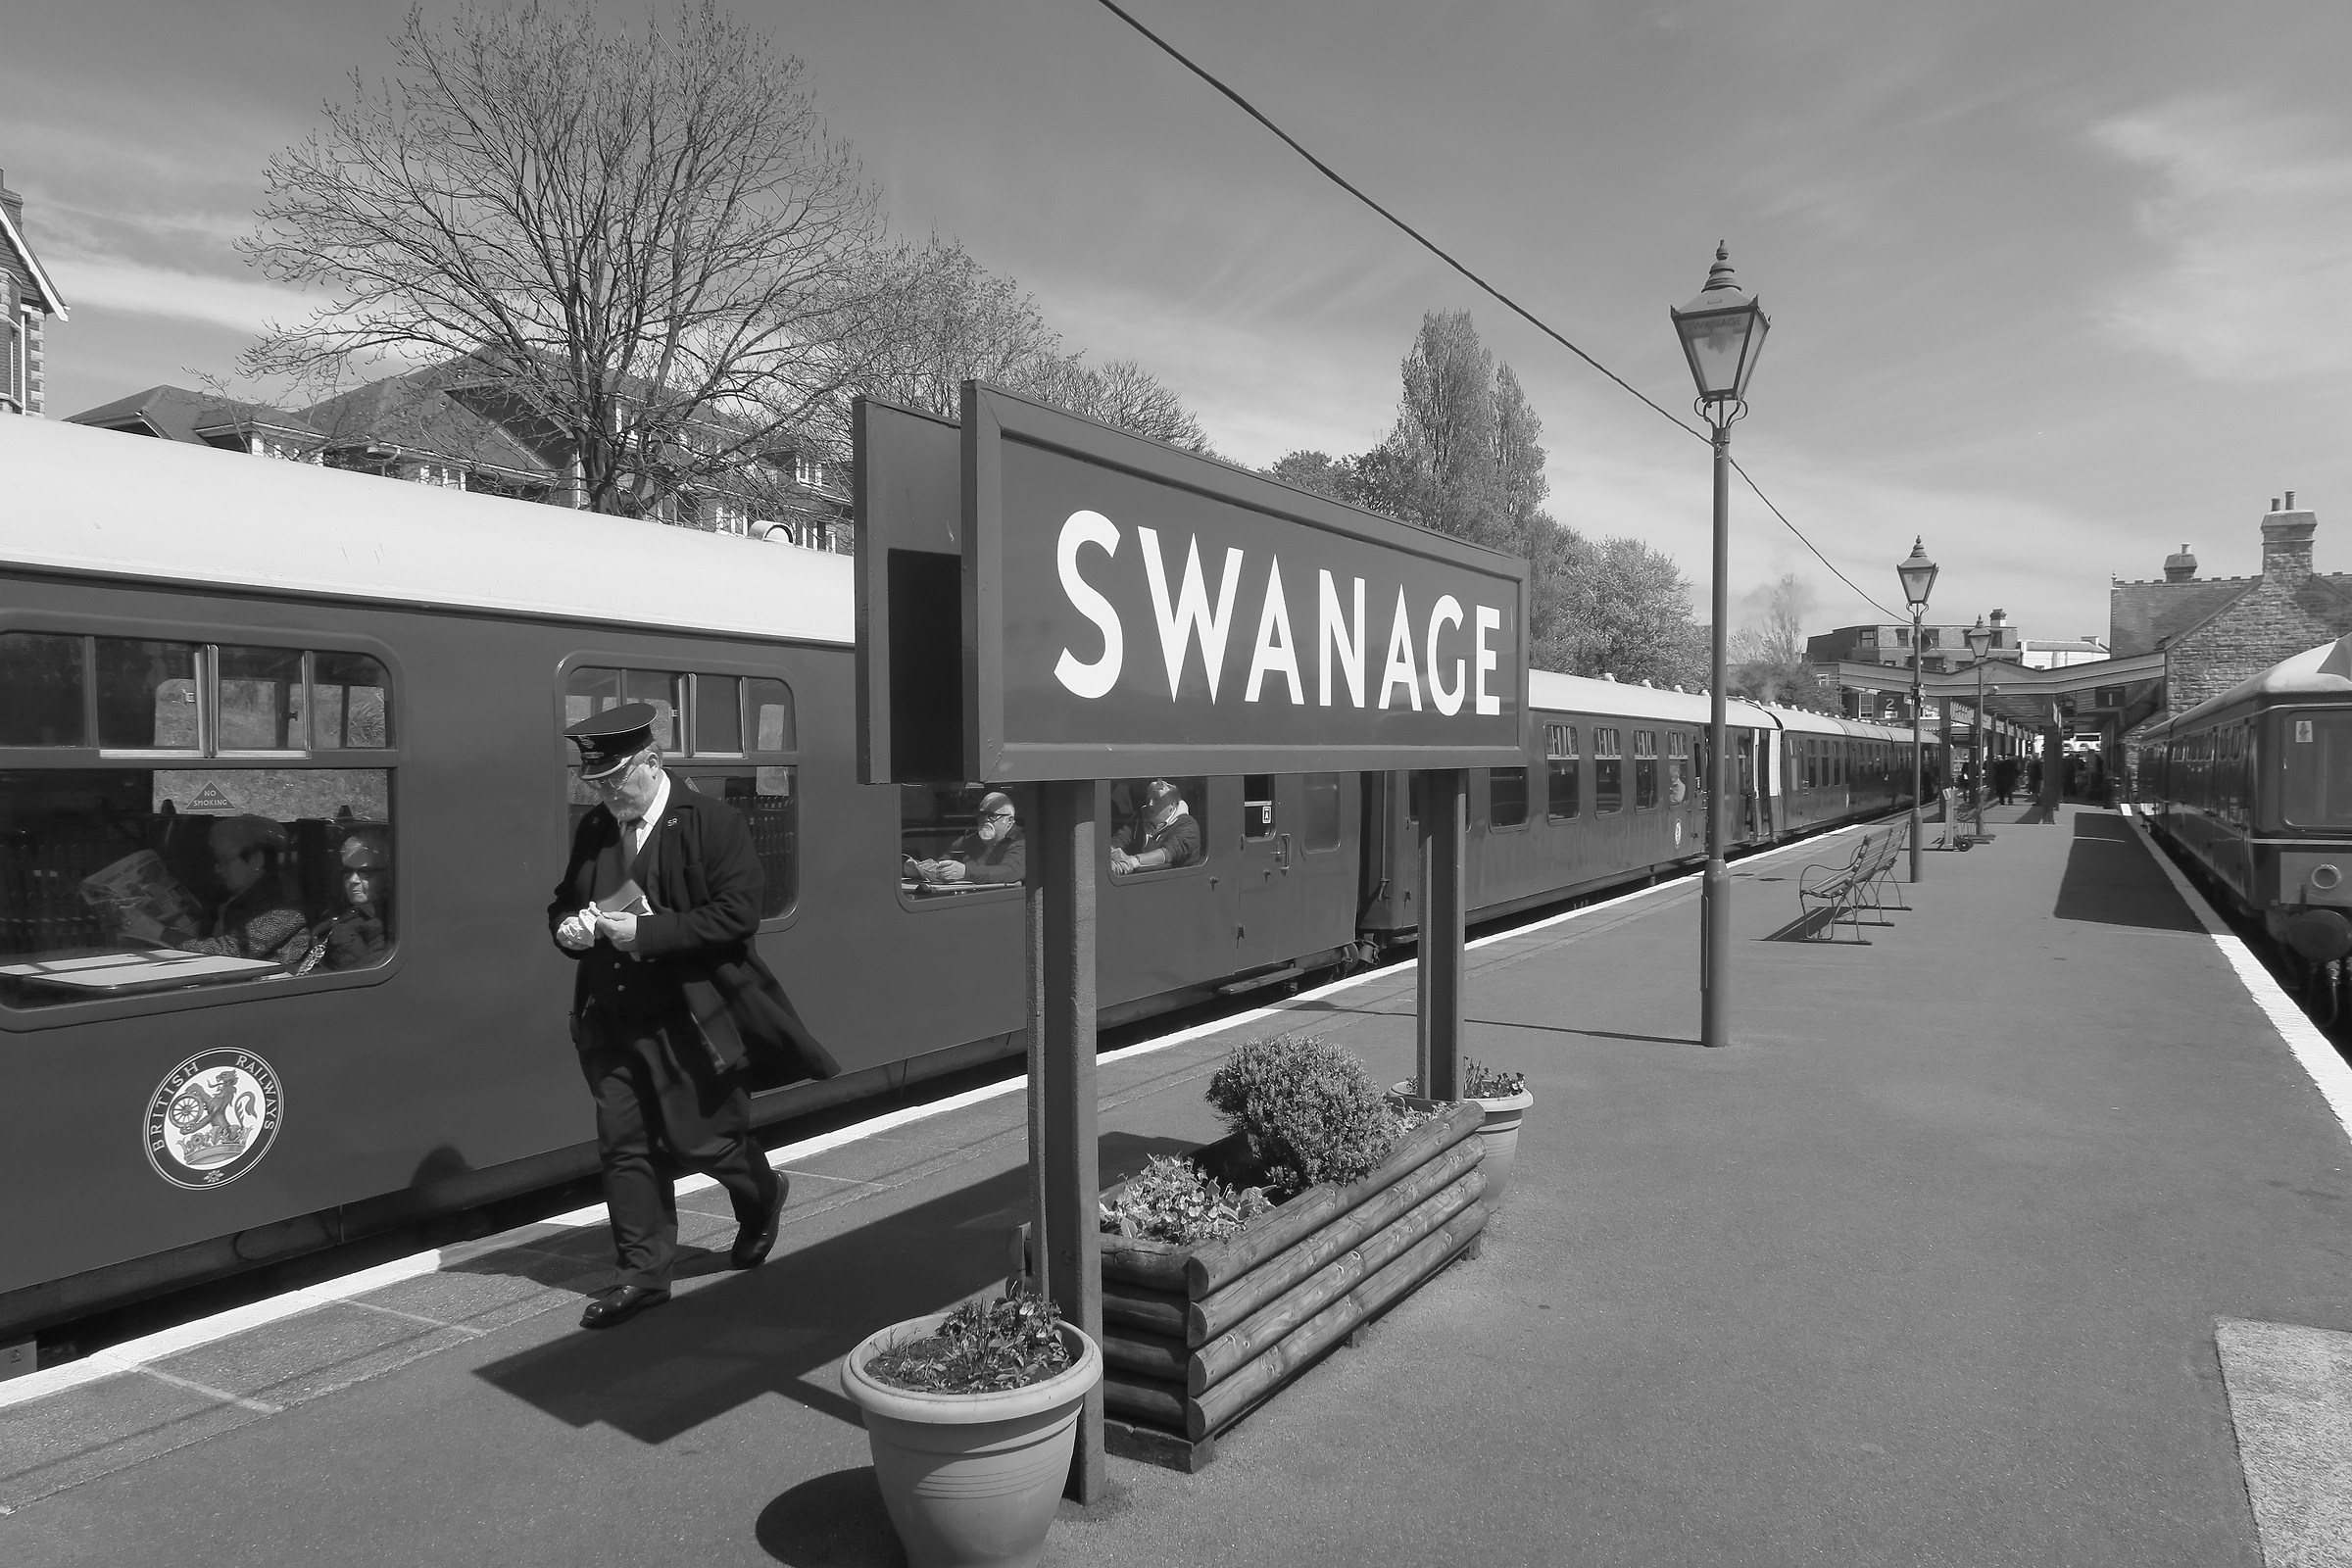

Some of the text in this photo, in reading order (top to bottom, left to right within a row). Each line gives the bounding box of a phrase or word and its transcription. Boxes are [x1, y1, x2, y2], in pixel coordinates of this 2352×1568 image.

[1054, 510, 1501, 716] SWANAGE
[1886, 698, 1895, 710] 2
[667, 817, 678, 828] SR
[150, 1054, 278, 1152] BRITISH RAILWAYS
